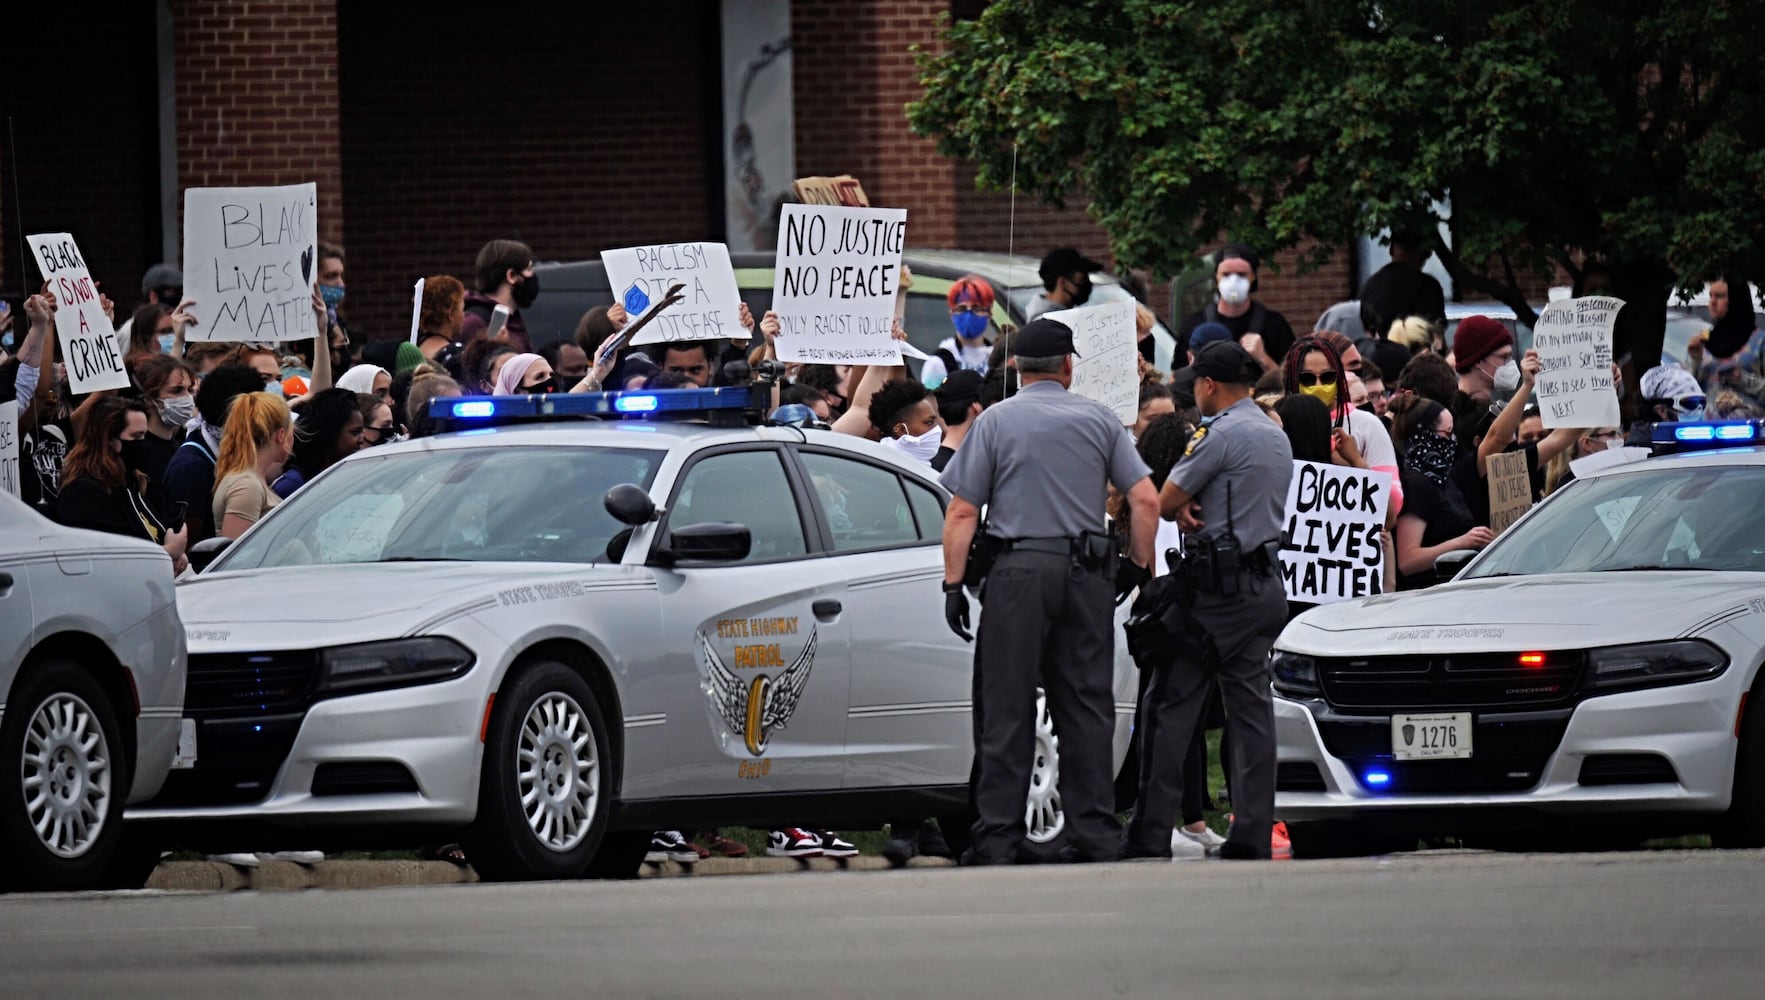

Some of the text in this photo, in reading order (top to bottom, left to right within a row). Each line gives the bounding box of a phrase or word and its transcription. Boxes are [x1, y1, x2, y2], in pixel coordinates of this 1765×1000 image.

[222, 200, 307, 249] BLACK
[786, 213, 907, 257] NO JUSTICE
[40, 240, 85, 273] BLACK
[635, 245, 708, 272] RACISM
[71, 276, 95, 305] NOT
[694, 276, 710, 305] A
[783, 264, 894, 299] NO PEACE
[79, 308, 90, 335] A
[657, 311, 727, 341] DISEASE
[780, 313, 890, 337] ONLY RACIST POLICE
[70, 334, 123, 382] CRIME
[1551, 400, 1575, 417] NEXT
[1279, 514, 1384, 567] LIVES
[498, 580, 585, 606] STATE TROOPER
[717, 616, 798, 638] STATE HIGHWAY
[1388, 628, 1504, 640] STATE TROOPER
[734, 643, 785, 669] PATROL
[1421, 725, 1457, 748] 1276
[738, 757, 772, 779] OHIO
